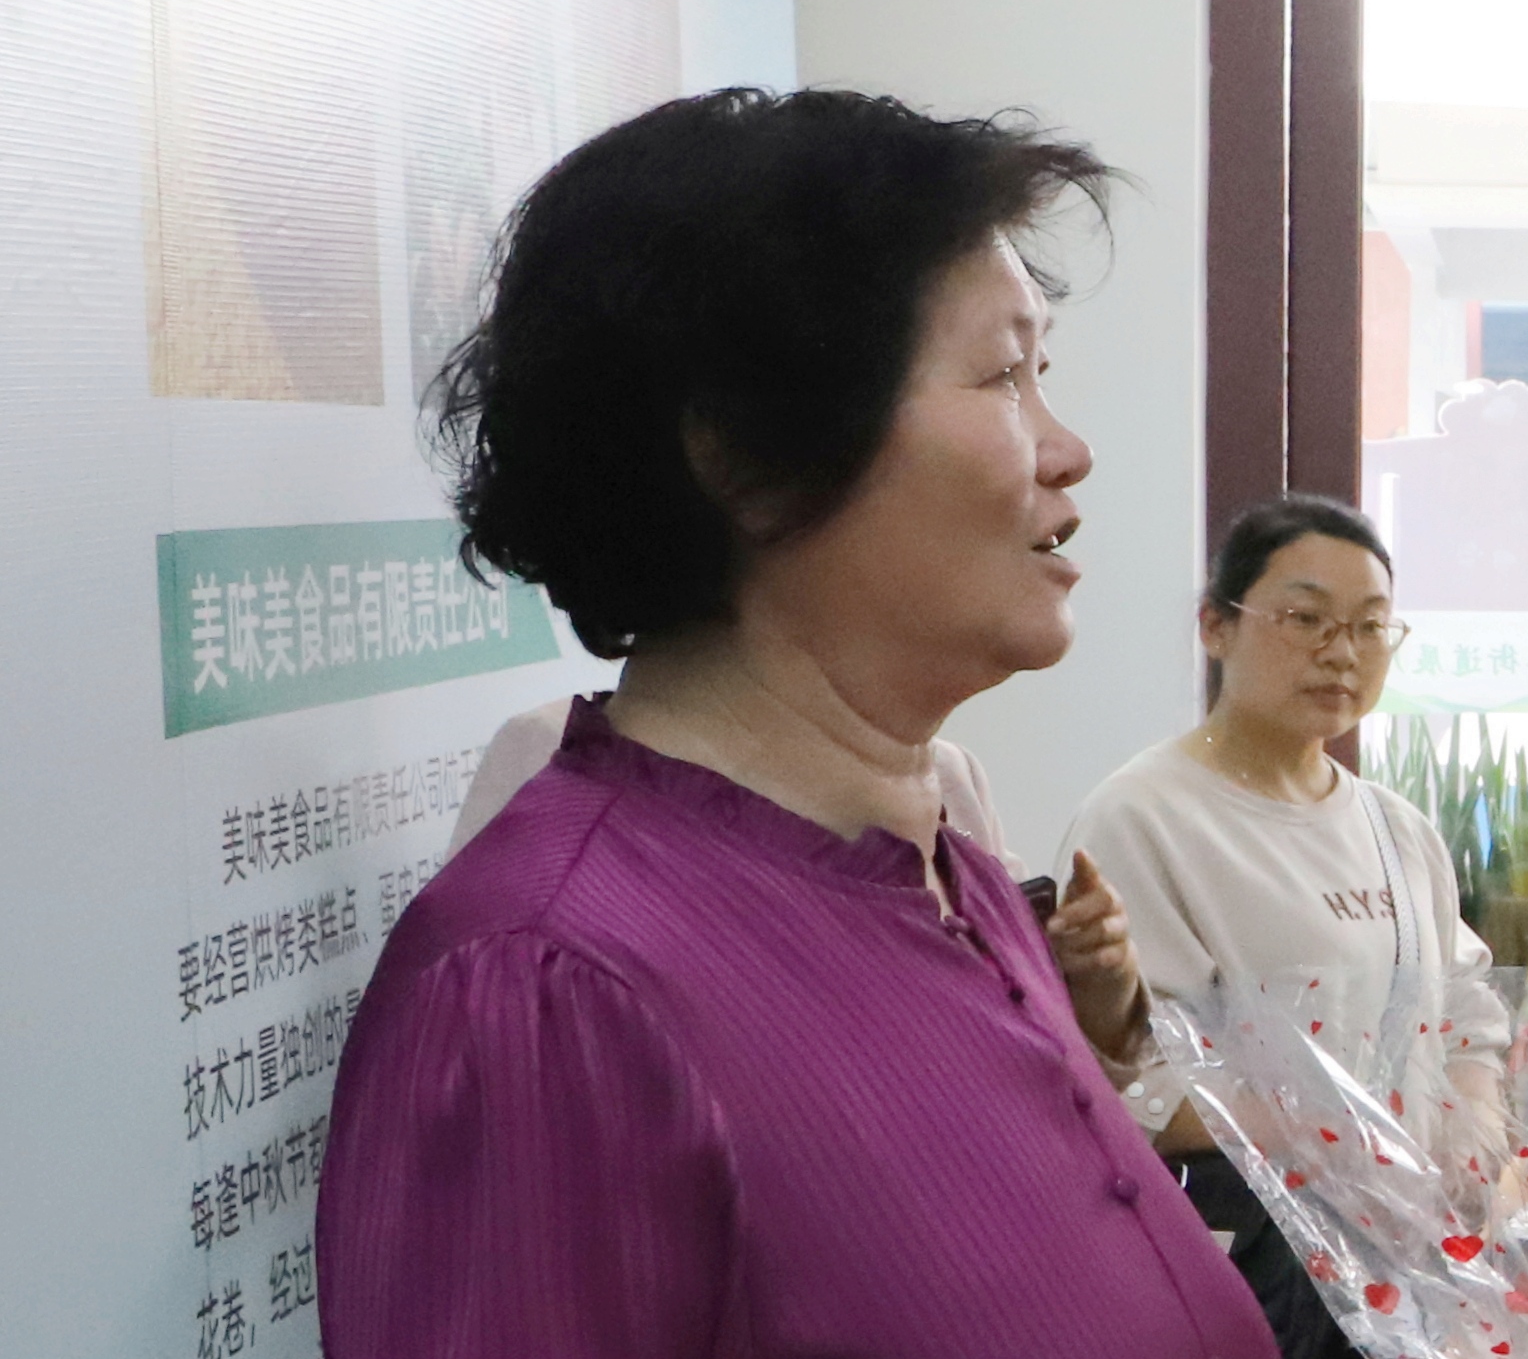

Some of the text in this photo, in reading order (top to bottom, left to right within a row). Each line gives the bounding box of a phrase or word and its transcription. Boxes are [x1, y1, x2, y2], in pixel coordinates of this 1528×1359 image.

[191, 556, 510, 694] 美味美食品有限责任公司
[222, 744, 485, 885] 美味美食品有限责任公司位于
